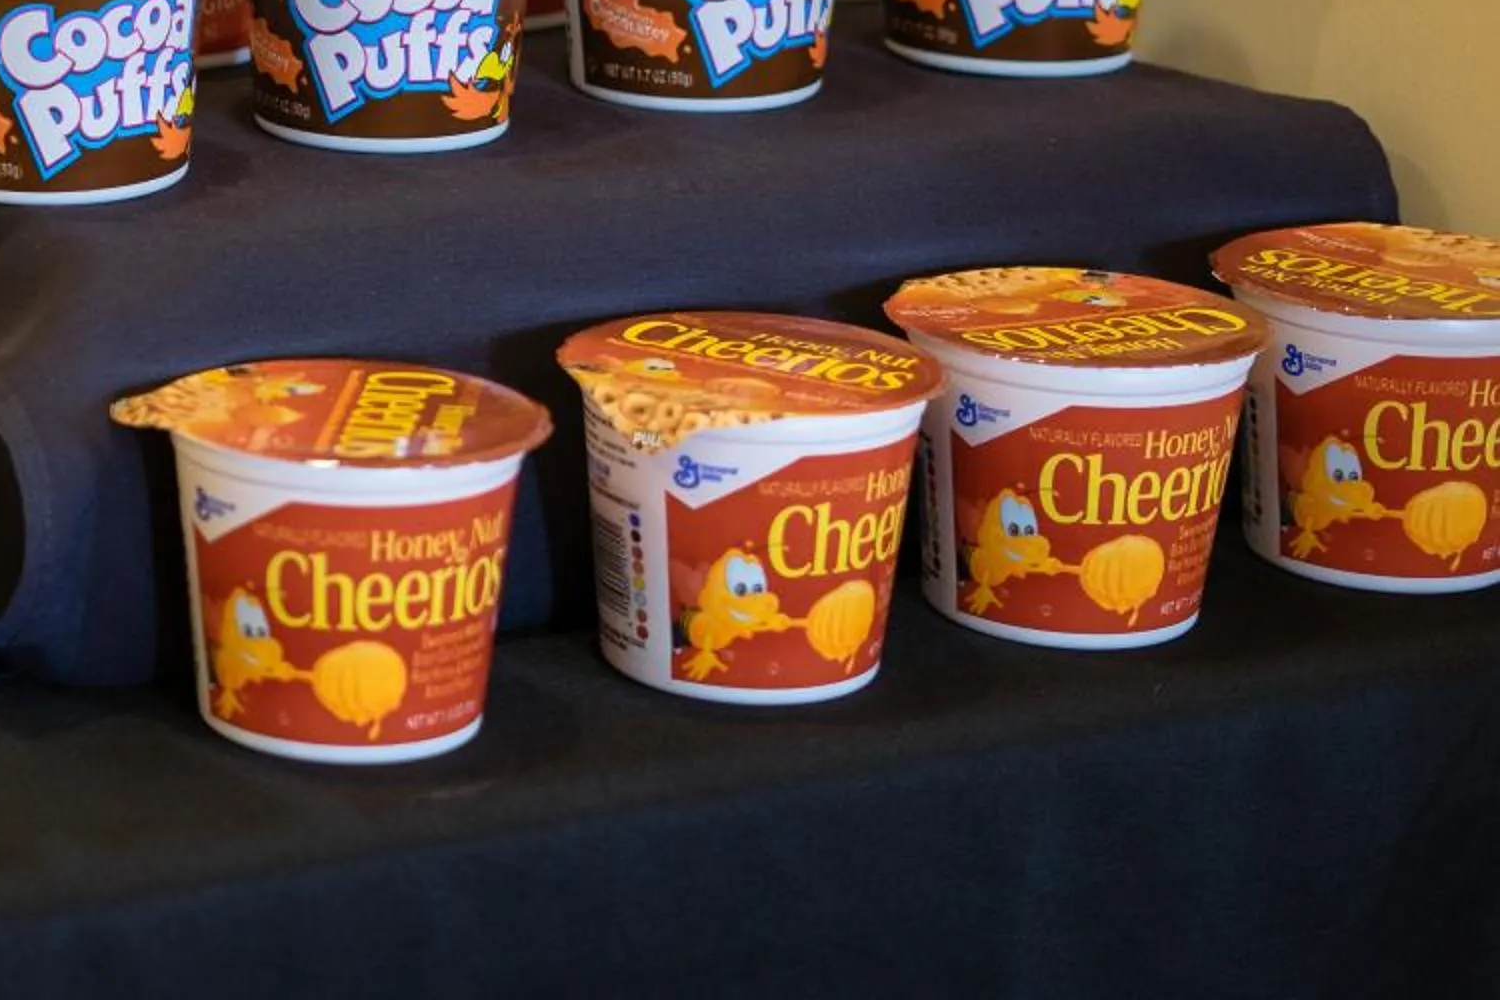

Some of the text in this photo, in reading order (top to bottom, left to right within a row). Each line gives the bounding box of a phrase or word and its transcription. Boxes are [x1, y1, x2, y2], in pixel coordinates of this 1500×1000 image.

[308, 7, 499, 112] Puffs
[17, 47, 195, 169] Puffs
[1246, 249, 1500, 315] heerios
[961, 307, 1248, 351] Cheerios
[622, 320, 914, 390] Cheerios
[855, 349, 918, 369] Nut
[1355, 375, 1414, 395] NATURALLY
[1415, 380, 1468, 396] FLAVORED
[1029, 426, 1090, 447] NATURALLY
[1090, 432, 1142, 448] FLAVORED
[1144, 424, 1222, 460] Honey
[865, 468, 910, 503] Hon
[370, 528, 466, 564] Honey
[767, 500, 906, 579] Cheer
